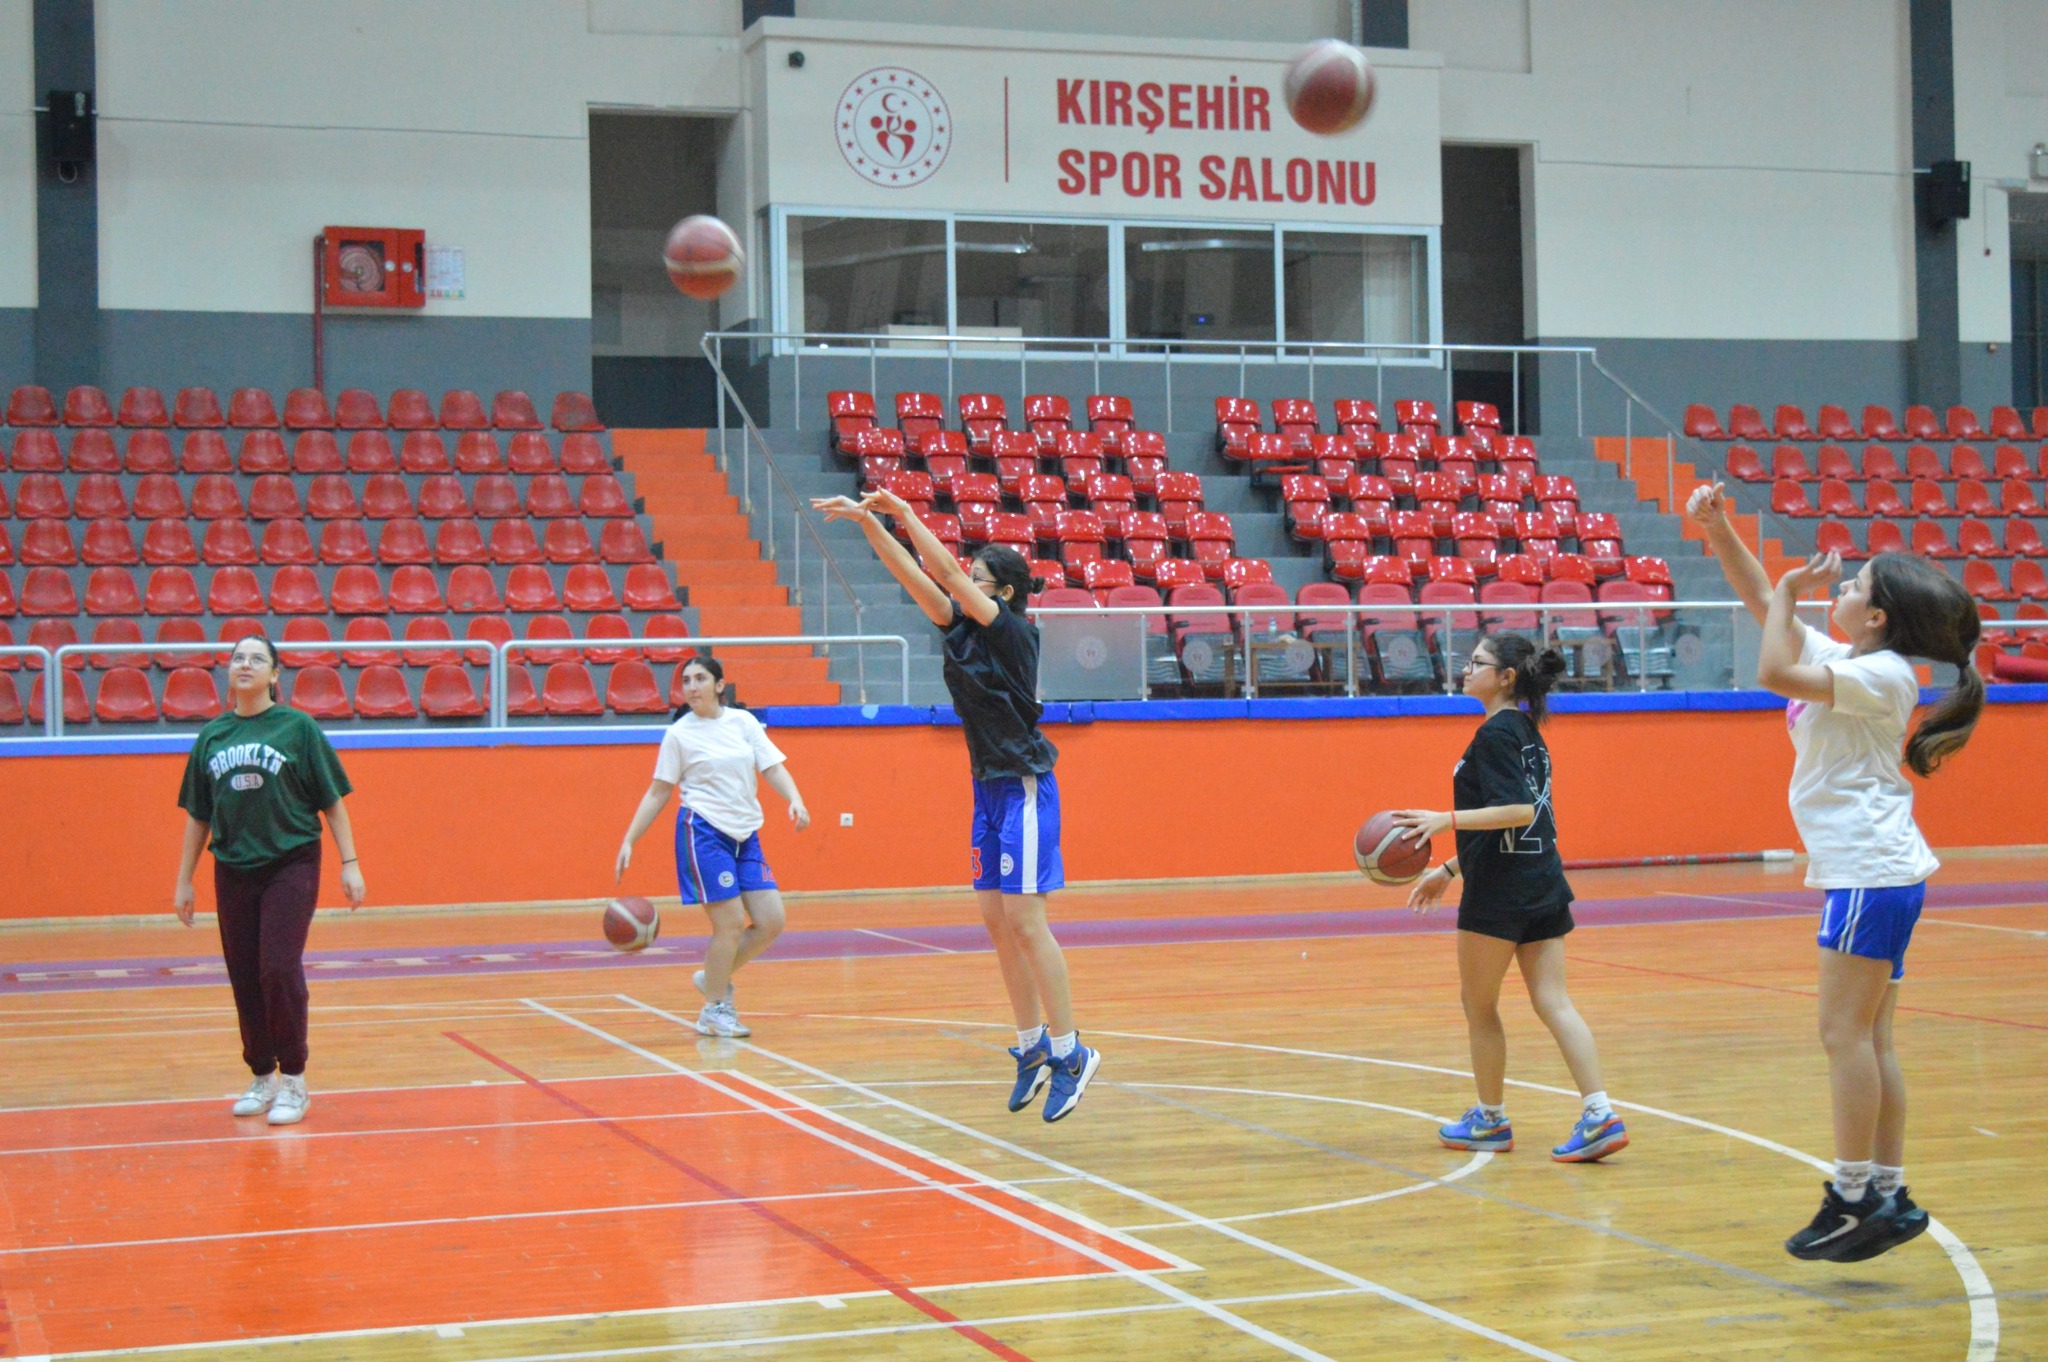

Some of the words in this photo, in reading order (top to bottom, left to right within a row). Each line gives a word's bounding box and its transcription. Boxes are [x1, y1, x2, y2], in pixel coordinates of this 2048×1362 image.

[1056, 75, 1271, 134] KIRŞEHİR
[1057, 149, 1182, 198] SPOR
[1199, 154, 1377, 206] SALONU
[209, 743, 287, 780] BROOKLYN
